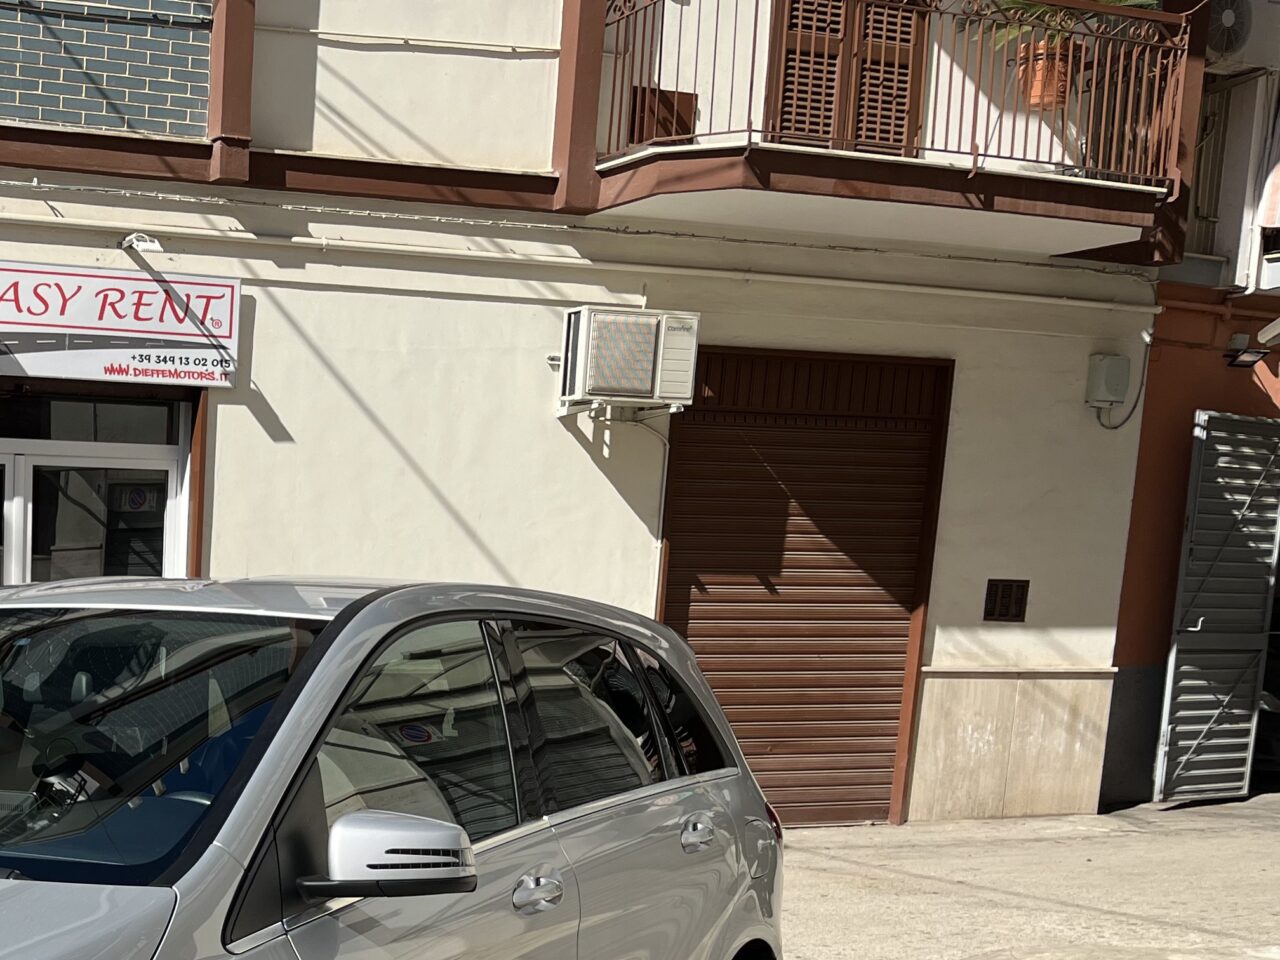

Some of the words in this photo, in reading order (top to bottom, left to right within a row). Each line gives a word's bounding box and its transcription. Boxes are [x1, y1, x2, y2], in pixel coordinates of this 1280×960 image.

[130, 353, 151, 364] +39
[154, 354, 176, 365] 349
[178, 356, 190, 367] 13
[193, 357, 208, 368] 02
[211, 358, 231, 369] 015
